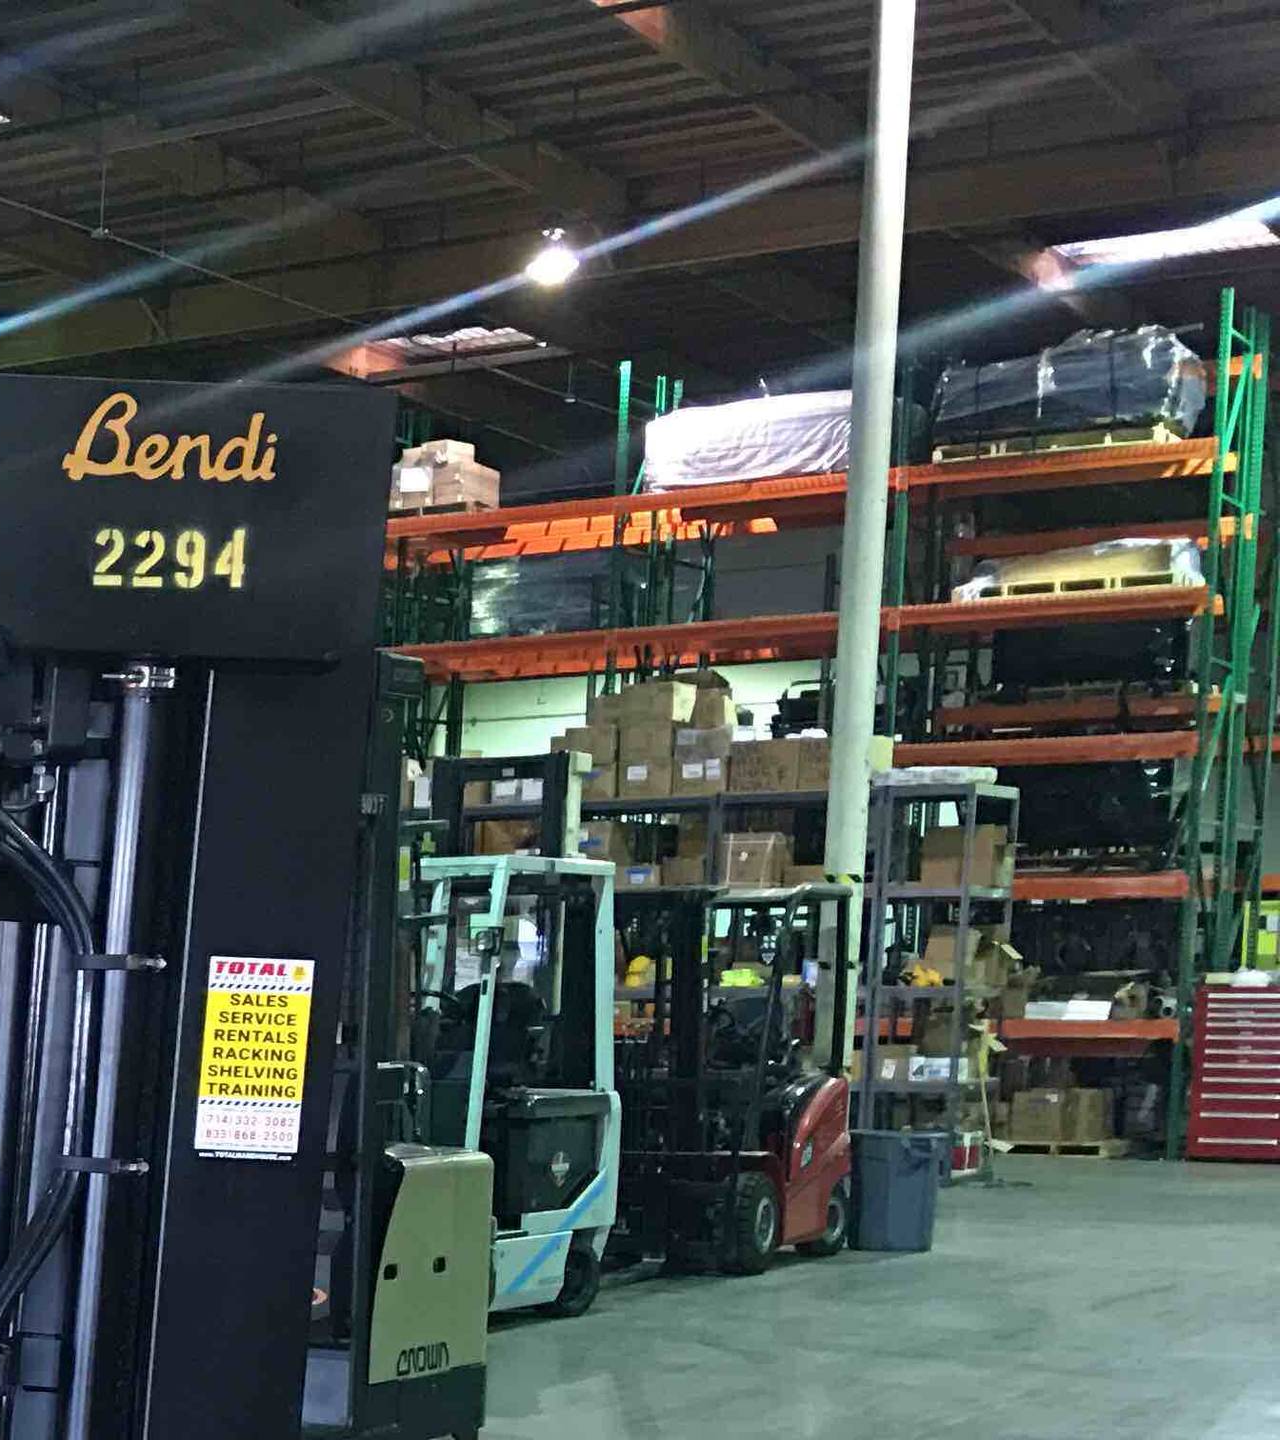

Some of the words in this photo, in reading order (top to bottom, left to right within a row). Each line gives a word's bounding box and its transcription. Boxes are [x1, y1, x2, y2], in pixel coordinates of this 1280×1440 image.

[62, 392, 277, 482] Bendi
[92, 527, 247, 589] 2294
[214, 960, 289, 977] TOTAL
[229, 993, 289, 1009] SALES
[218, 1010, 298, 1026] SERVICE
[213, 1028, 298, 1045] RENTALS
[212, 1046, 297, 1062] RACKING
[207, 1064, 299, 1081] SHELVING
[206, 1082, 297, 1099] TRAINING
